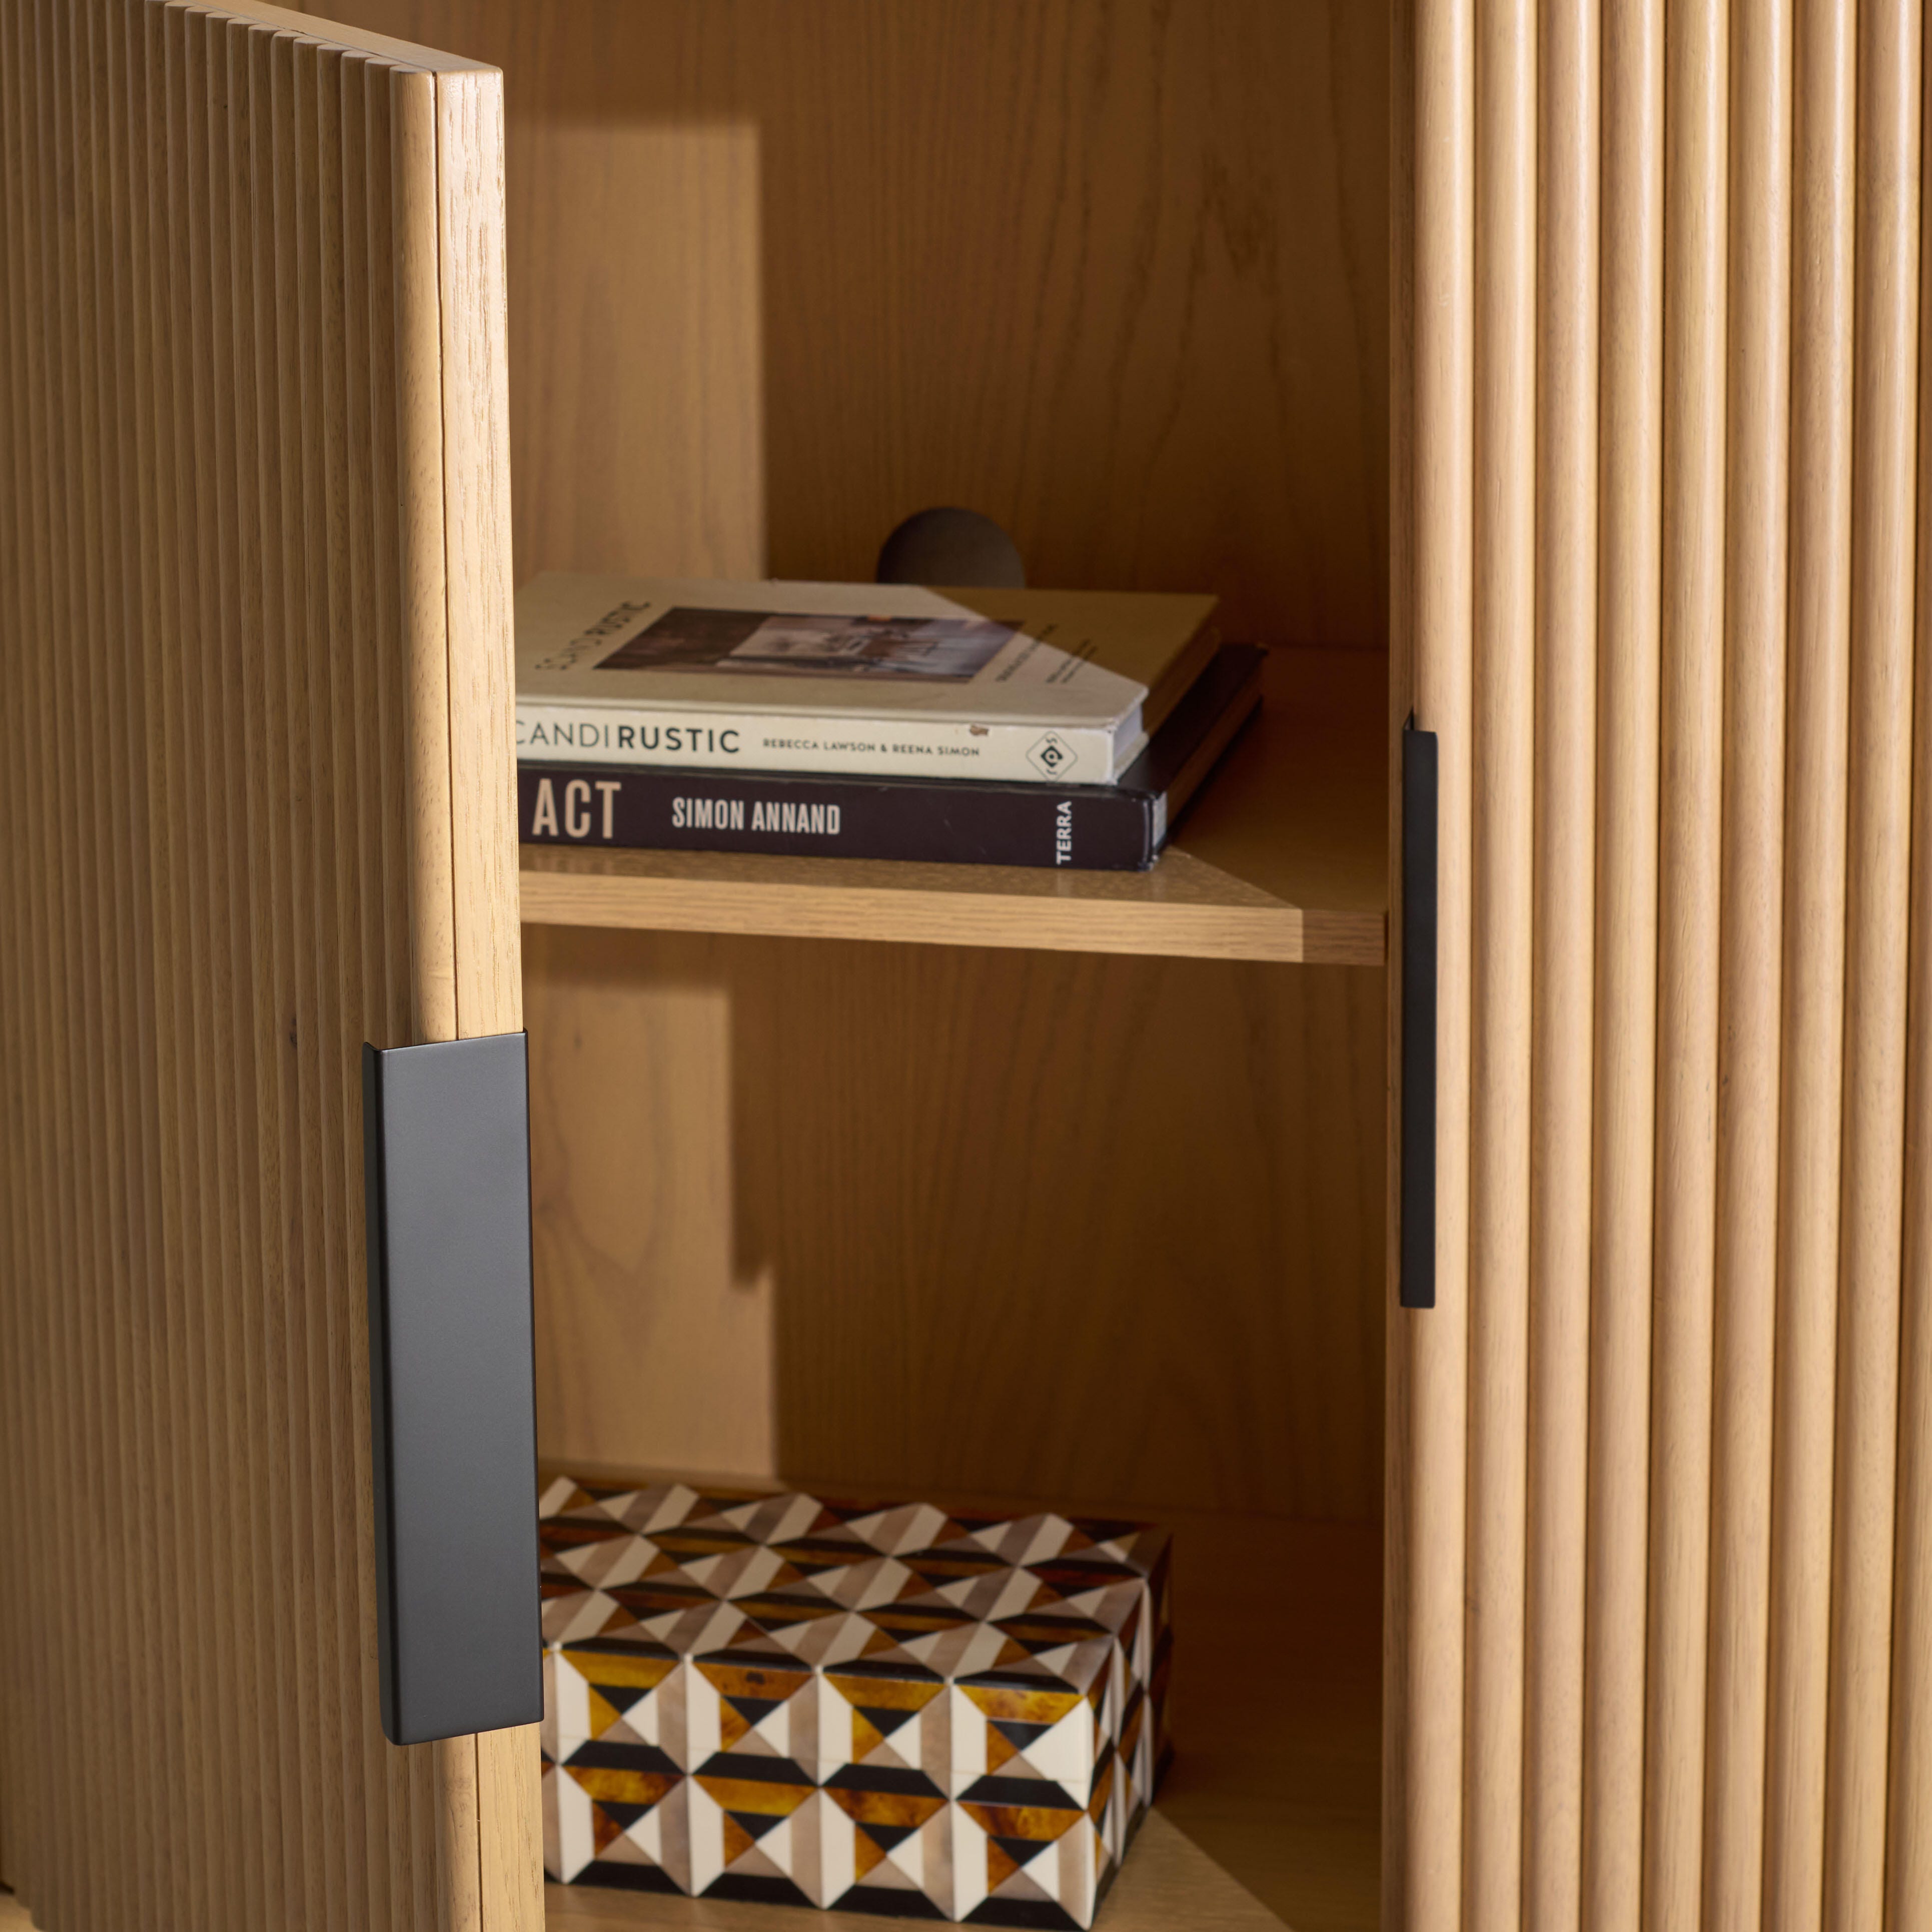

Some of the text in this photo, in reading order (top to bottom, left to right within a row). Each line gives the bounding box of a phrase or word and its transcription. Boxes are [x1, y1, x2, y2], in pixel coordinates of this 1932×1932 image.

[763, 738, 980, 756] REBECCA LAWSON & REENA SIMON
[532, 778, 621, 839] ACT
[672, 797, 840, 835] SIMON ANNAND
[1056, 801, 1072, 864] TERRA
